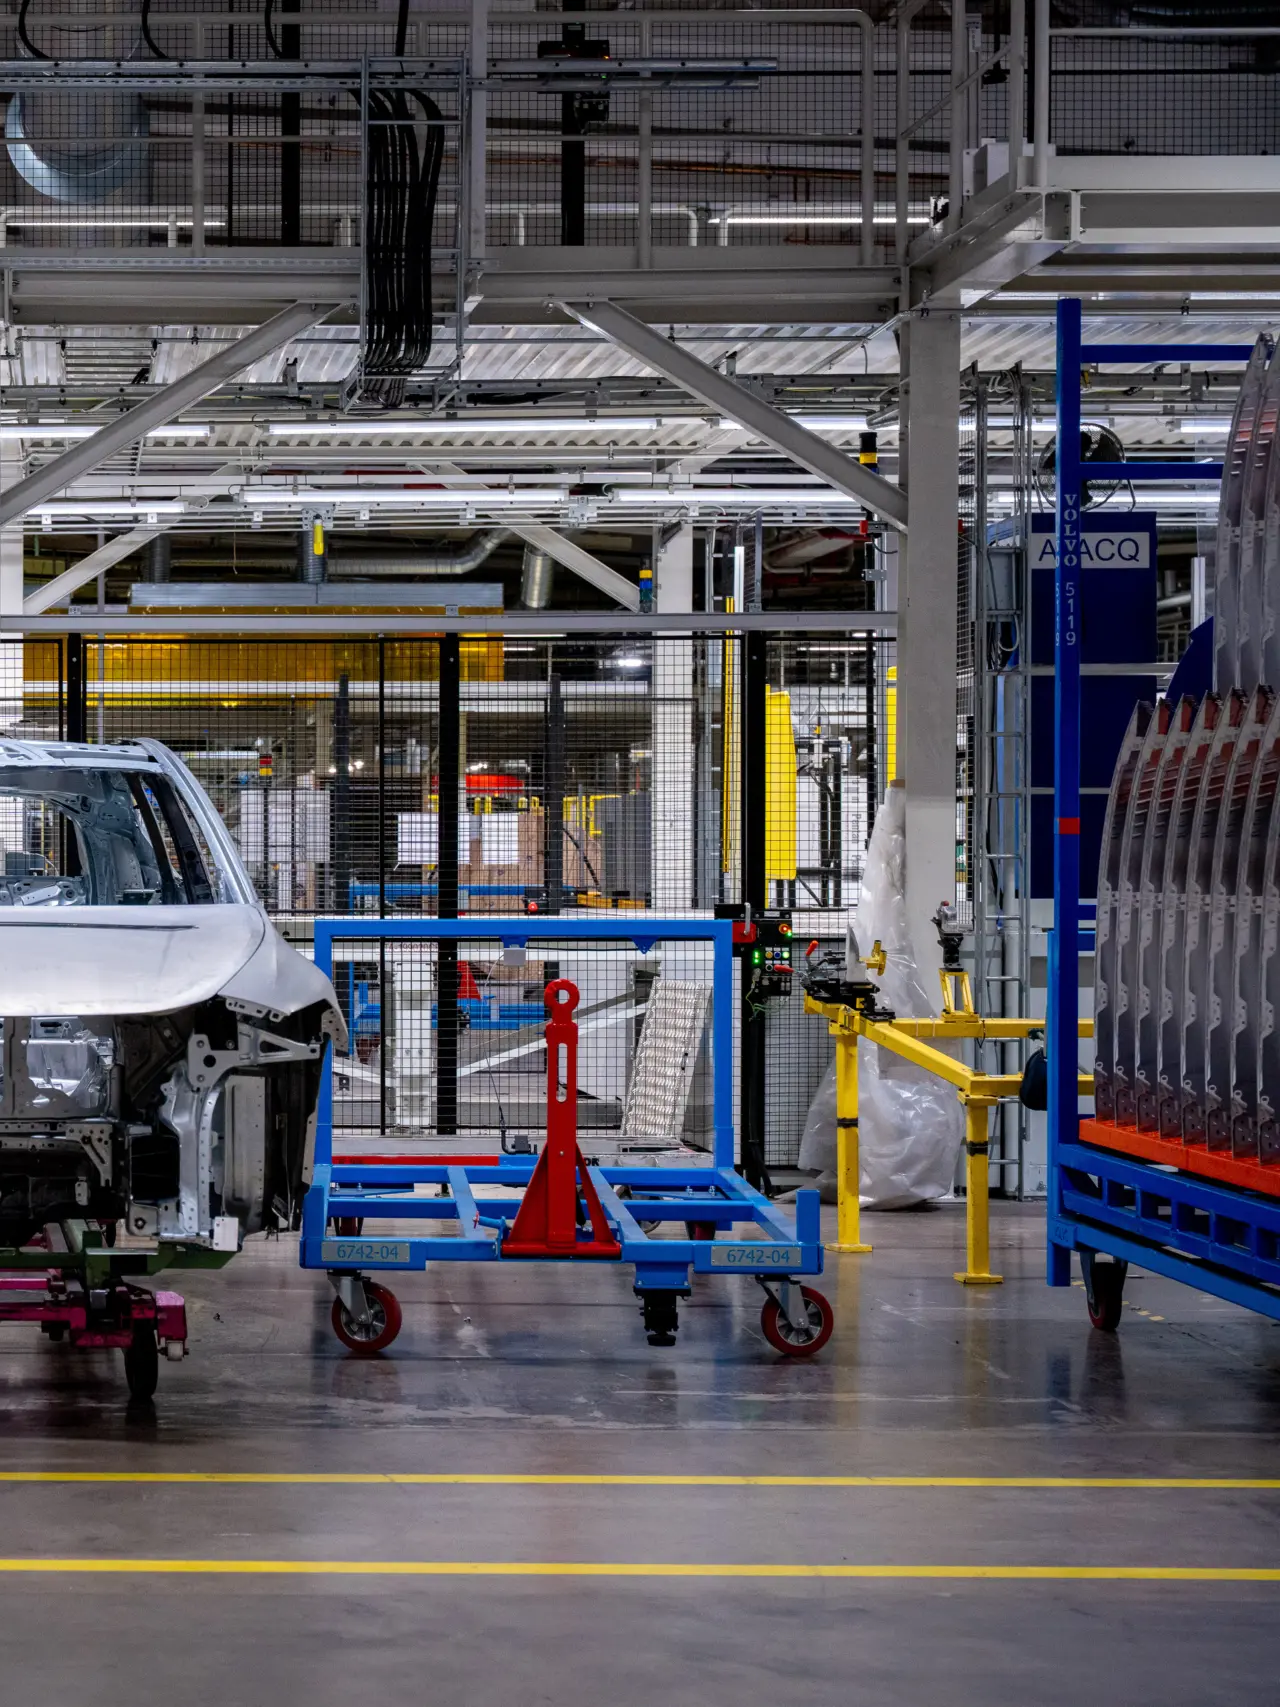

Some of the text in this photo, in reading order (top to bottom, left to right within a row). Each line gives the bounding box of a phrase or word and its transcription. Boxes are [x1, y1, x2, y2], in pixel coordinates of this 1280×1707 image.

[1038, 538, 1140, 562] AACQ
[1064, 494, 1078, 646] VOLVO 5119
[336, 1244, 399, 1260] 6742-04
[726, 1249, 791, 1264] 6742-04
